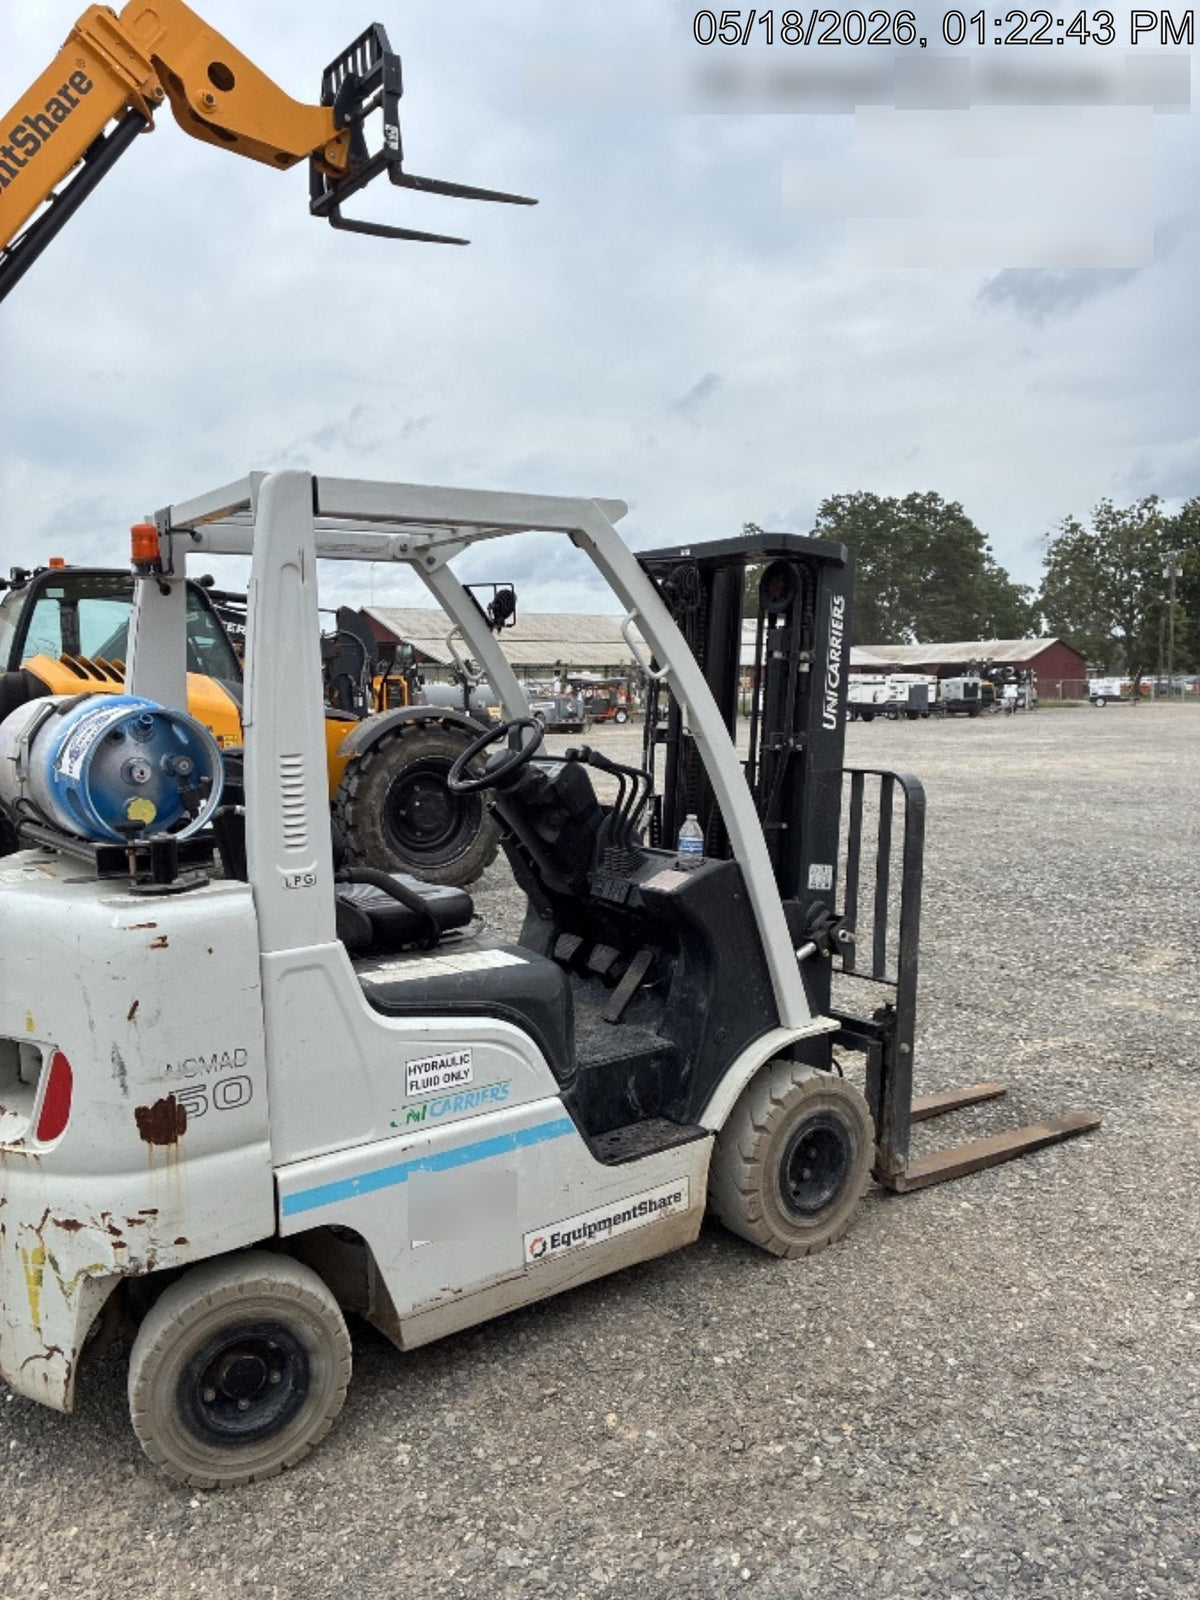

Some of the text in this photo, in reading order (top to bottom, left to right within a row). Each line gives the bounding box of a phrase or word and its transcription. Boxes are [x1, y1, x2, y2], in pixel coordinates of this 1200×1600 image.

[0, 70, 93, 194] ntShare
[822, 594, 845, 730] UNICARRIERS
[407, 1053, 471, 1077] HYDRAULIC
[409, 1067, 471, 1092] FLUID ONLY
[168, 1075, 253, 1119] 50
[389, 1082, 512, 1129] NICARRIERS
[549, 1190, 683, 1250] EquipmentShare
